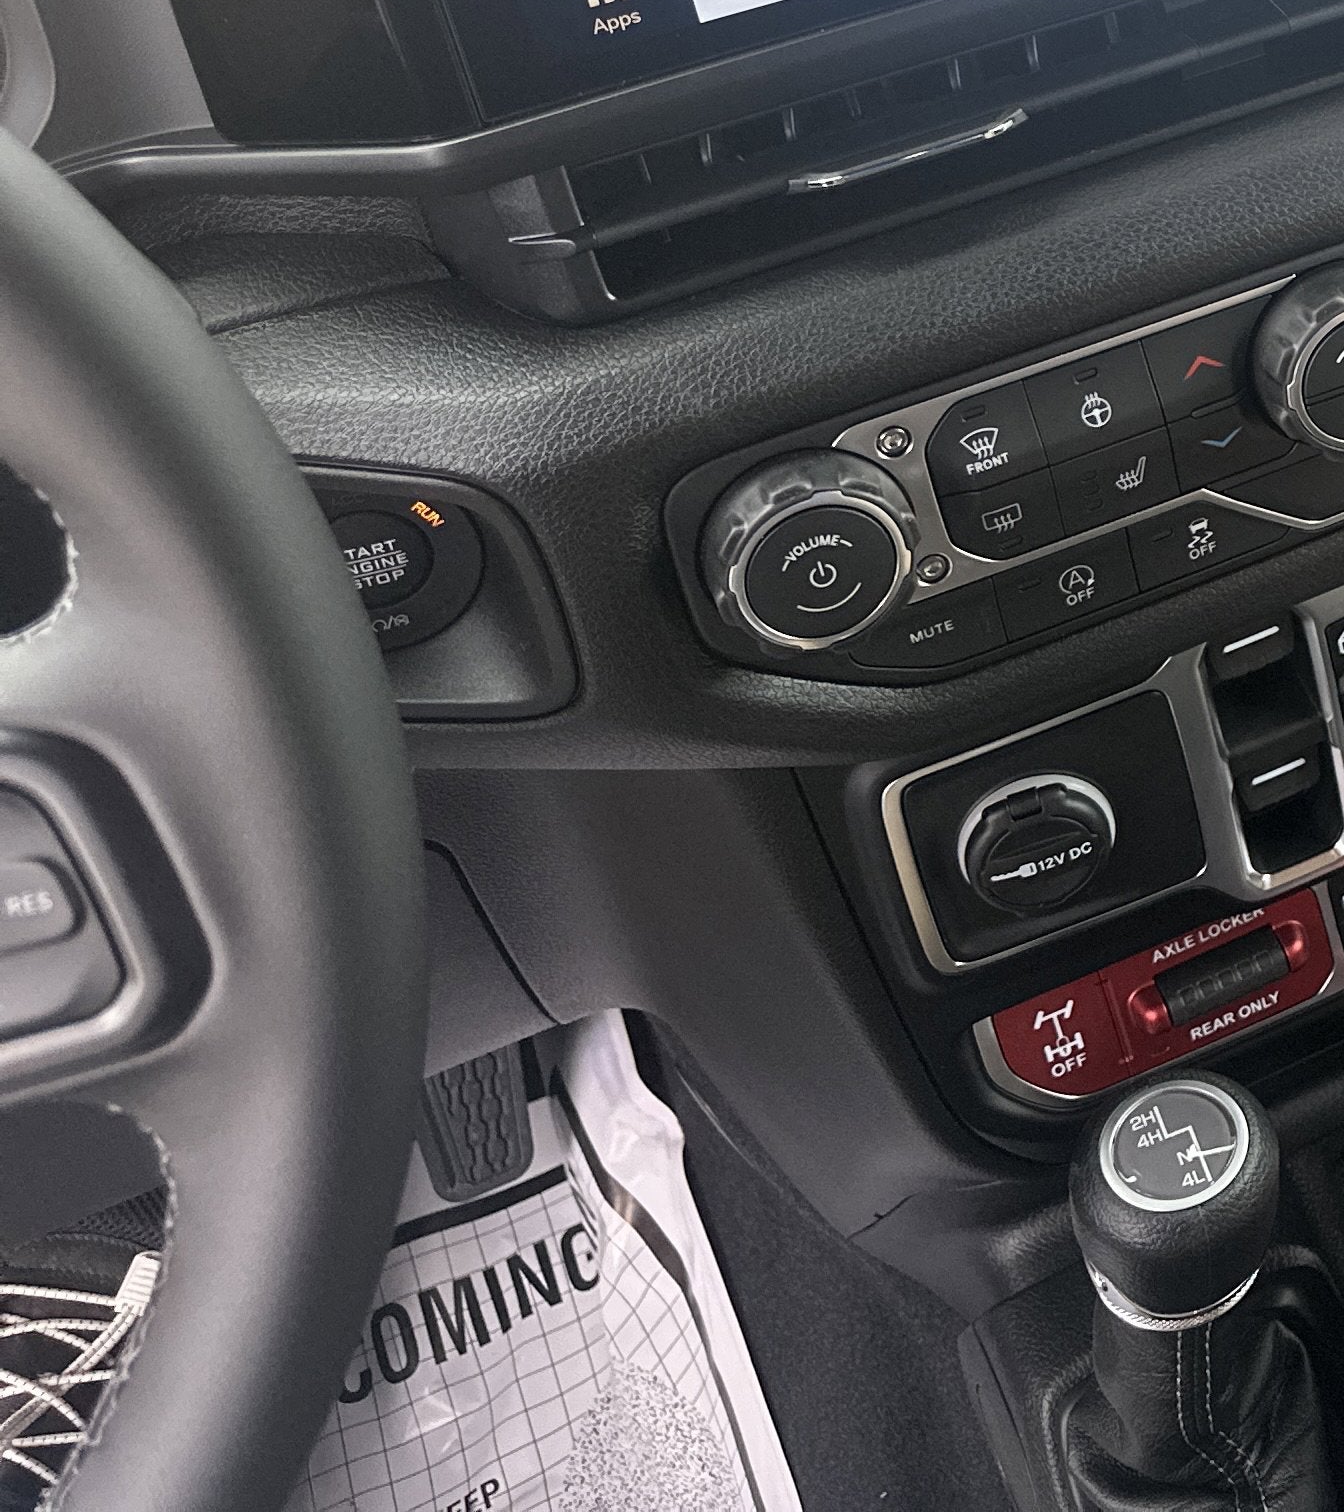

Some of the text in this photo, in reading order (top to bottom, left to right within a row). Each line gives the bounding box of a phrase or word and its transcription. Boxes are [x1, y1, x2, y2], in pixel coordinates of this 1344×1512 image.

[592, 9, 642, 36] Apps
[966, 451, 1010, 475] FRONT
[410, 501, 445, 528] RUN
[344, 538, 397, 560] TART
[785, 533, 841, 564] VOLUME
[1188, 540, 1218, 561] OFF
[347, 552, 409, 576] NGINE
[1065, 586, 1095, 607] OFF
[909, 619, 954, 643] MUTE
[1037, 841, 1093, 873] 12V DC
[5, 891, 53, 917] RES
[1151, 908, 1265, 964] AXLE LOCKER
[1189, 990, 1281, 1041] REAR ONLY
[1050, 1052, 1088, 1078] OFF
[1129, 1110, 1157, 1132] 2H
[1137, 1128, 1164, 1148] 4H
[1181, 1170, 1206, 1188] 4L
